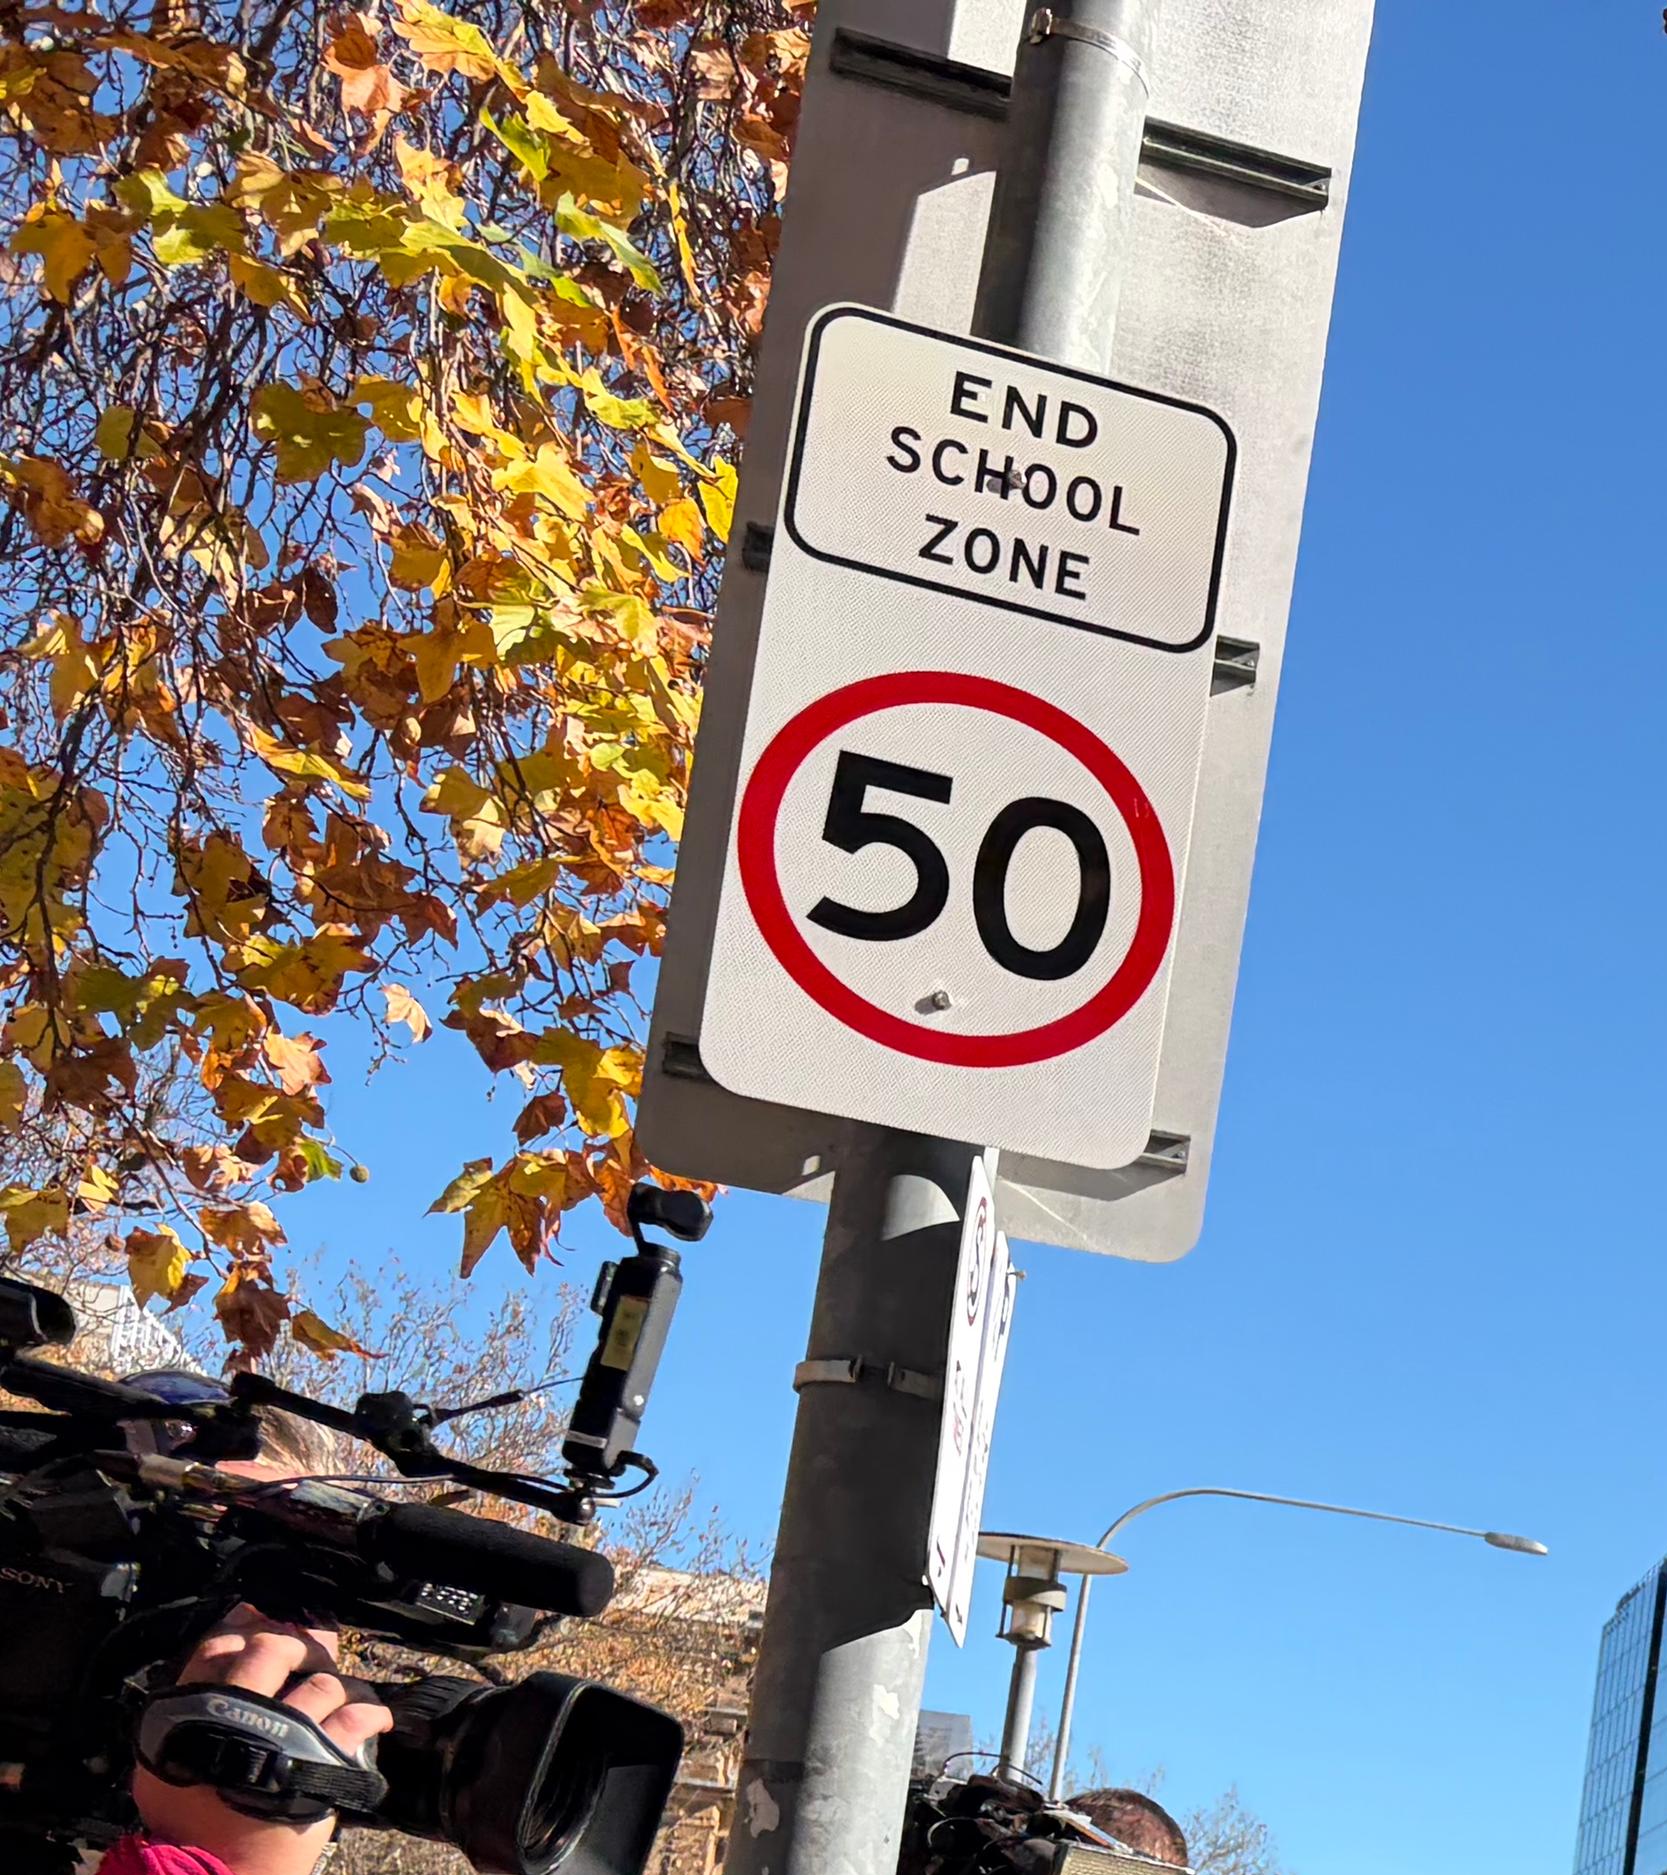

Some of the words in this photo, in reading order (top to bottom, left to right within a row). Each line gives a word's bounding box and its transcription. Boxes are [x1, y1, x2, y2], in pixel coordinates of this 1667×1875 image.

[949, 370, 1099, 450] END
[886, 427, 1141, 537] SCHOOL
[918, 514, 1092, 601] ZONE
[805, 750, 1111, 981] 50
[0, 1566, 73, 1594] SONY
[206, 1698, 289, 1738] Canon
